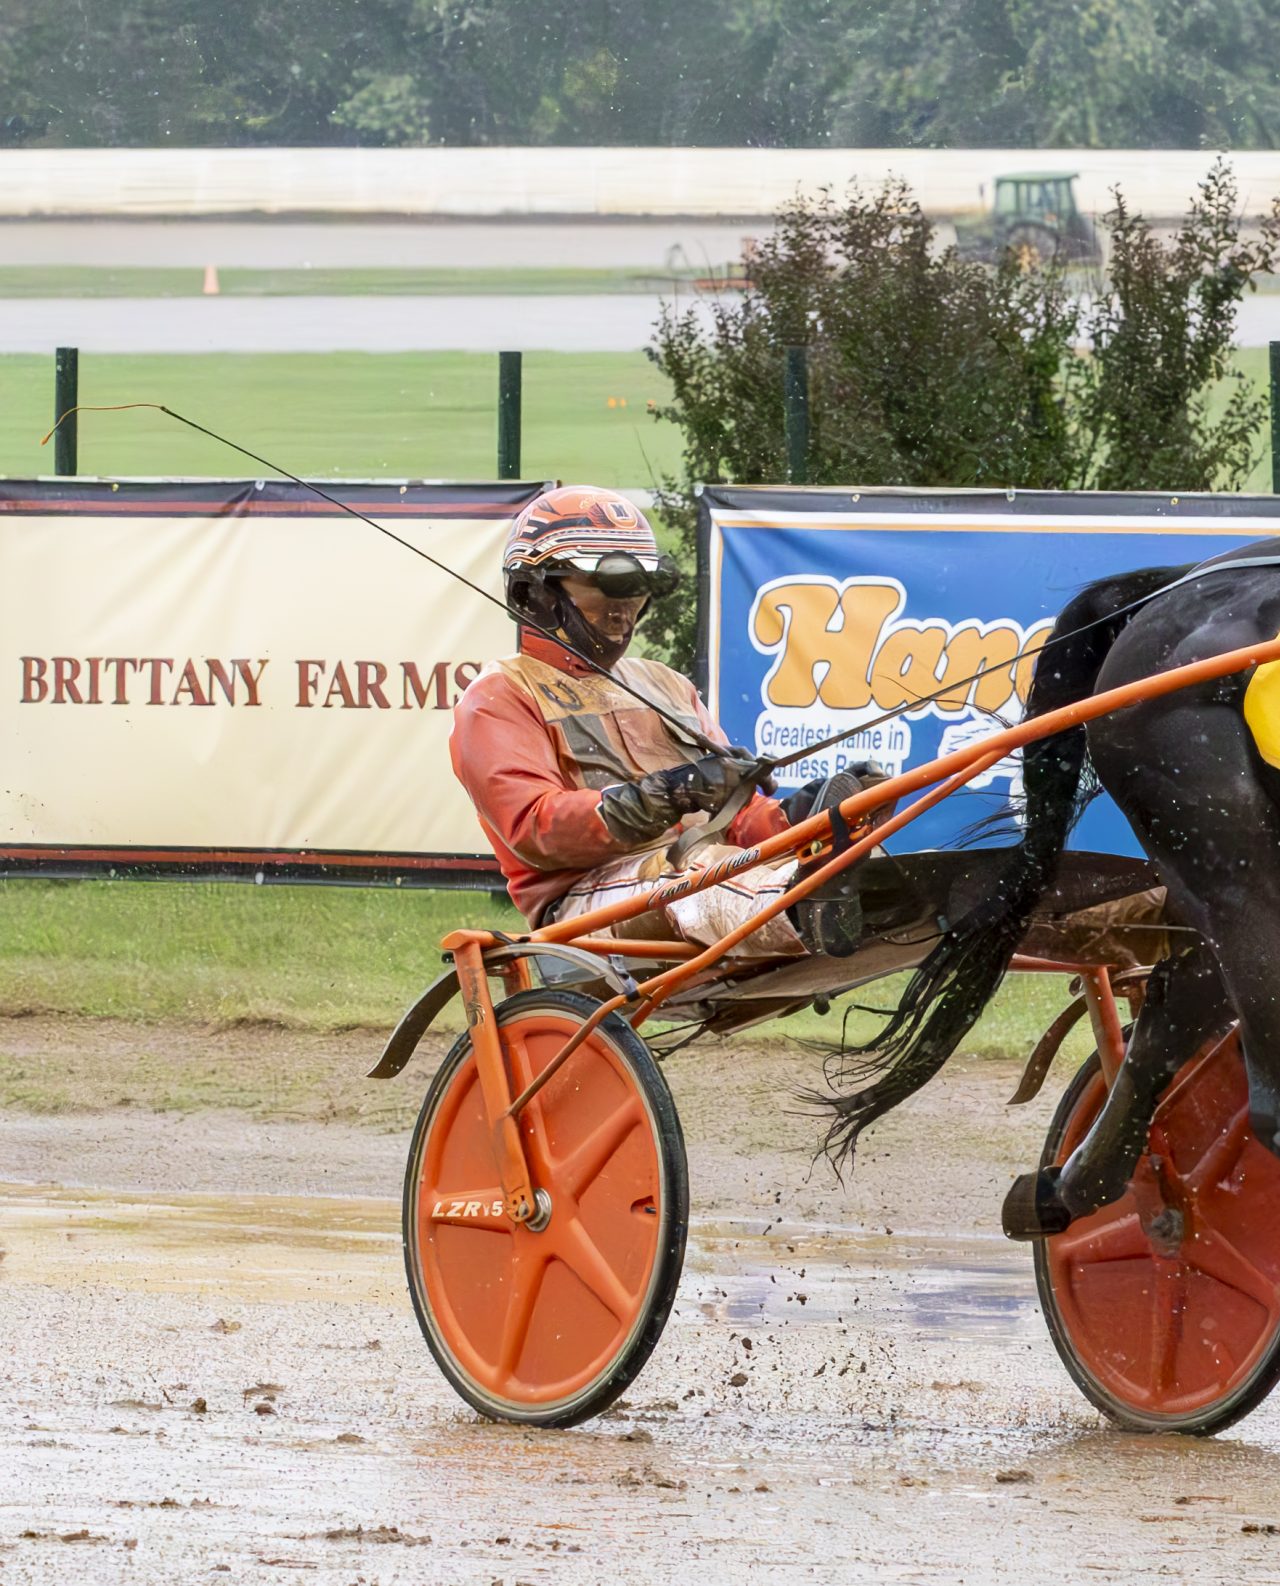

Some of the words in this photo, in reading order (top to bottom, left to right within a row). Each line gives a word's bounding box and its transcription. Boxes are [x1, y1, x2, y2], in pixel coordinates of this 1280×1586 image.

[19, 656, 269, 706] BRITTANY
[294, 659, 484, 709] FARMS
[761, 720, 831, 749] Greatest
[889, 724, 905, 751] in
[769, 754, 829, 779] arness
